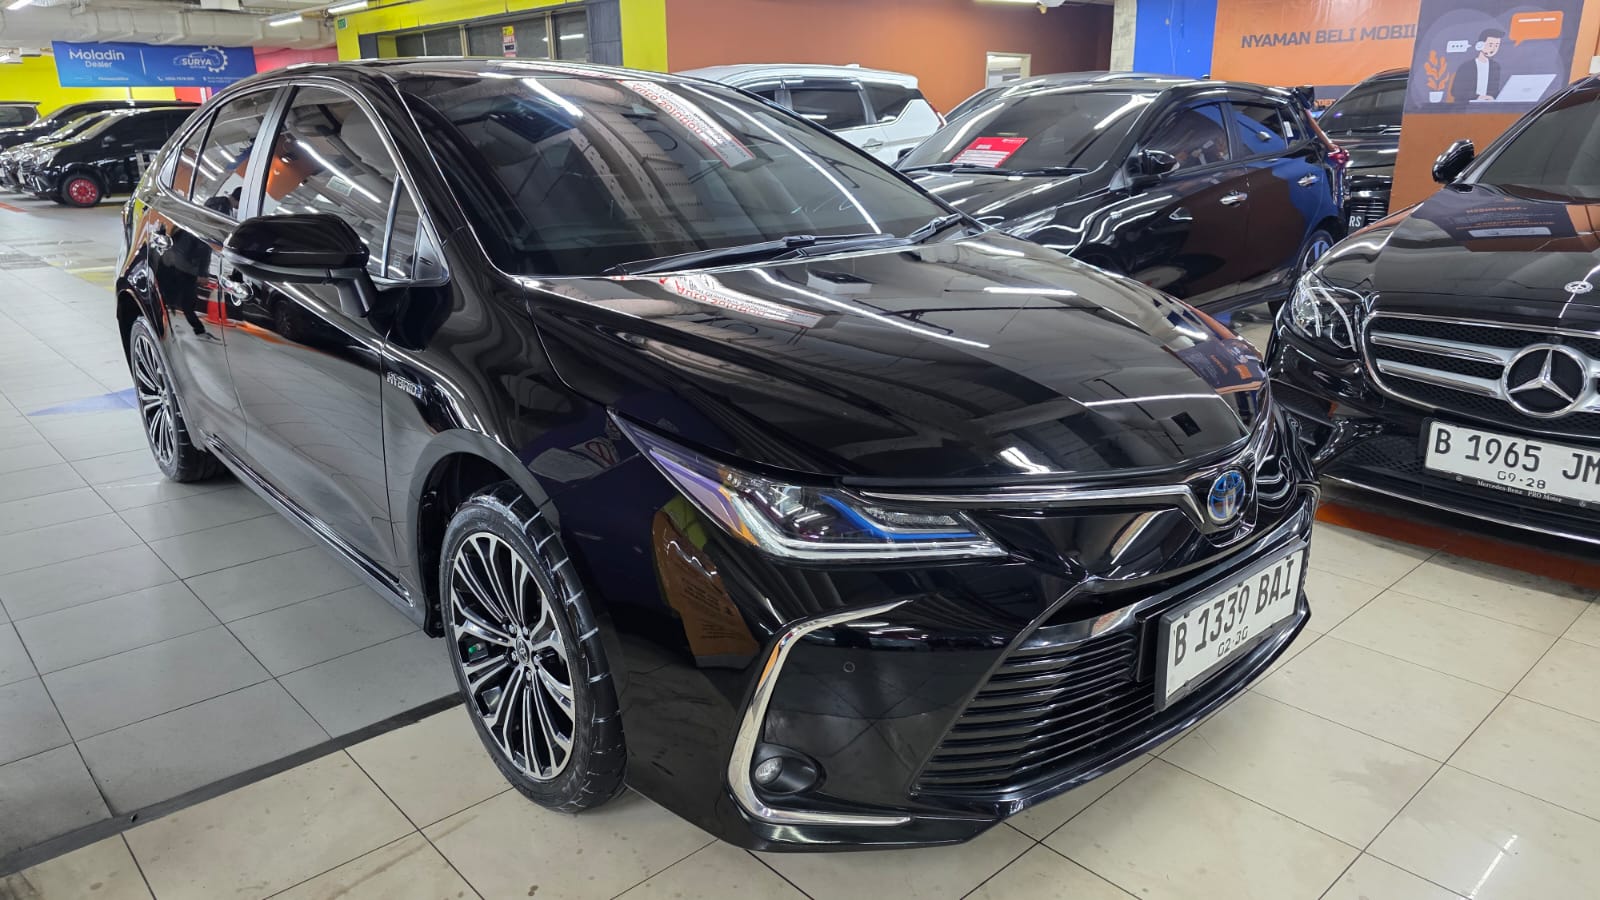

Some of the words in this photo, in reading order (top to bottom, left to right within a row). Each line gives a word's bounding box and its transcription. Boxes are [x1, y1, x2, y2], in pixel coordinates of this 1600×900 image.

[1241, 31, 1311, 49] NYAMAN
[1315, 27, 1356, 44] BELI
[69, 48, 125, 61] Moladin
[182, 57, 212, 66] SURYA
[85, 60, 112, 68] Dealer
[1349, 215, 1362, 227] RS
[387, 371, 416, 396] HYBRID
[1434, 428, 1451, 455] B
[1465, 434, 1542, 472] 1965
[1174, 621, 1187, 667] B
[1194, 585, 1250, 653] 1339
[1255, 559, 1294, 614] BAI
